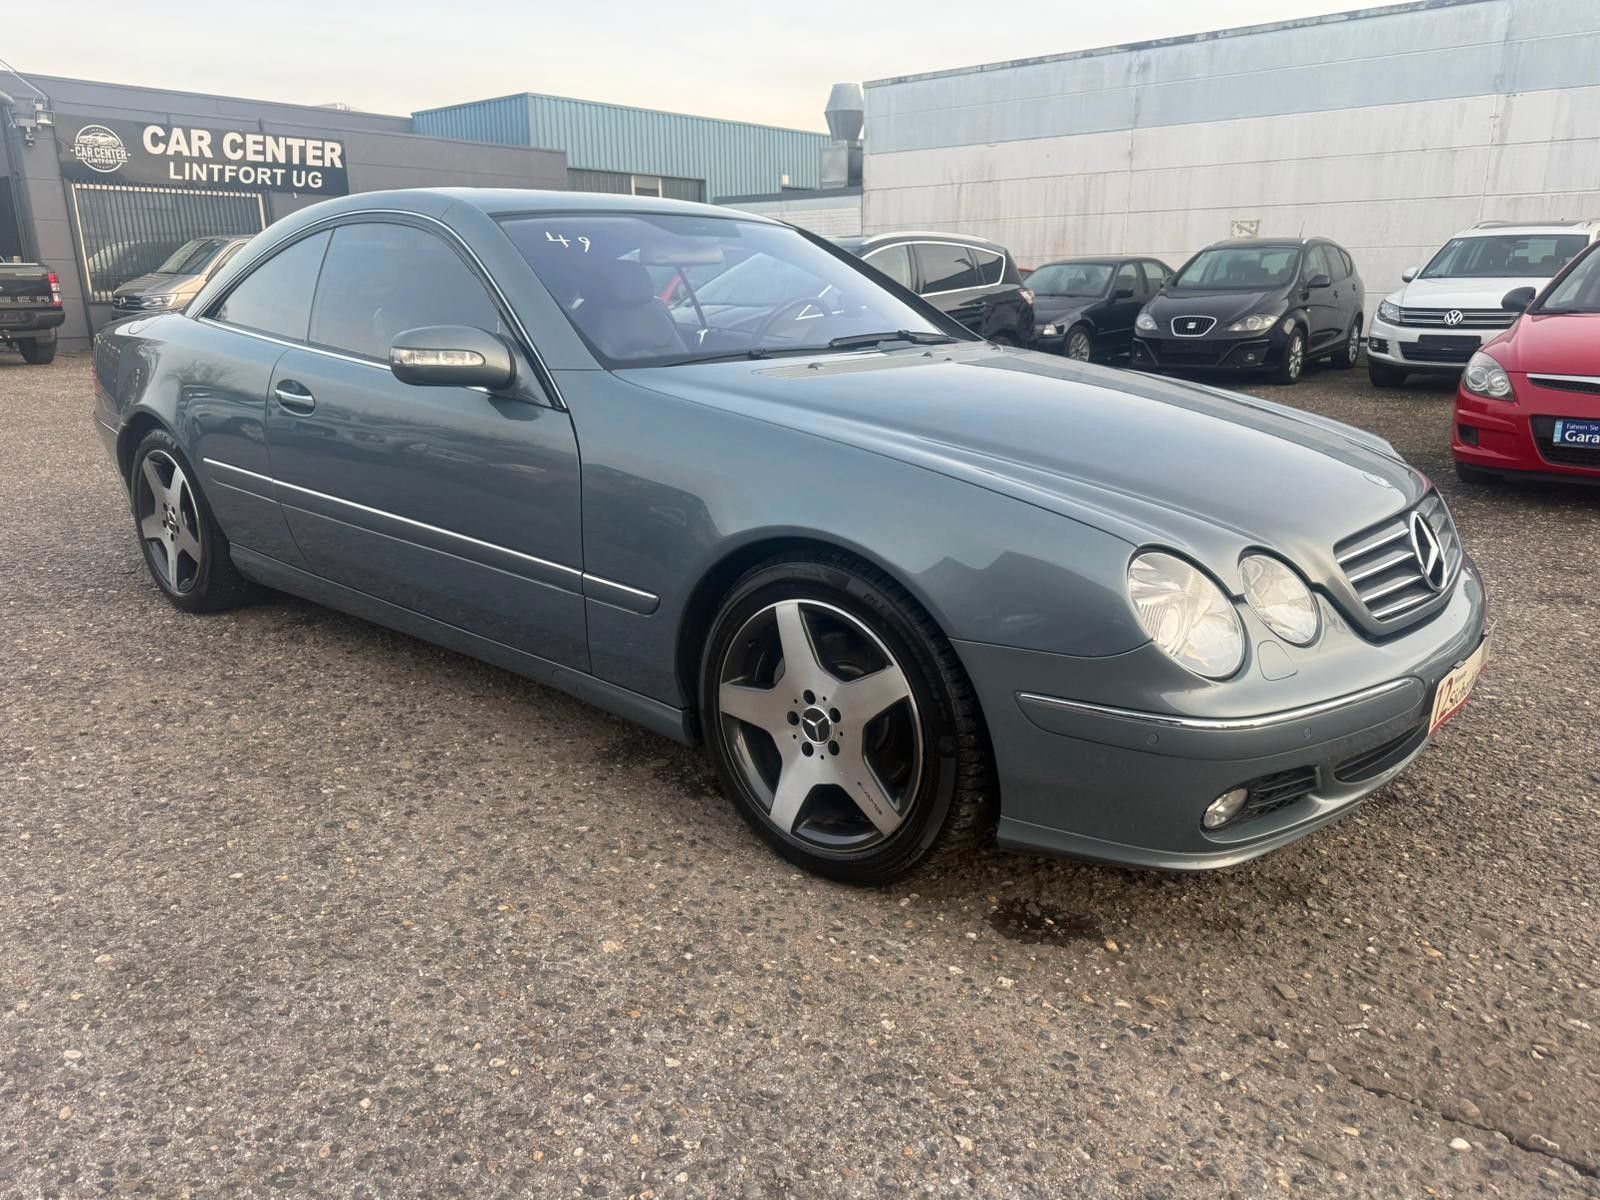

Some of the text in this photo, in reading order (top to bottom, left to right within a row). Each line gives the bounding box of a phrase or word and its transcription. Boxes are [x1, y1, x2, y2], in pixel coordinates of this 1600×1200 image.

[75, 146, 127, 160] CAR CENTER
[142, 125, 343, 169] CAR CENTER
[169, 161, 323, 188] LINTFORT UG
